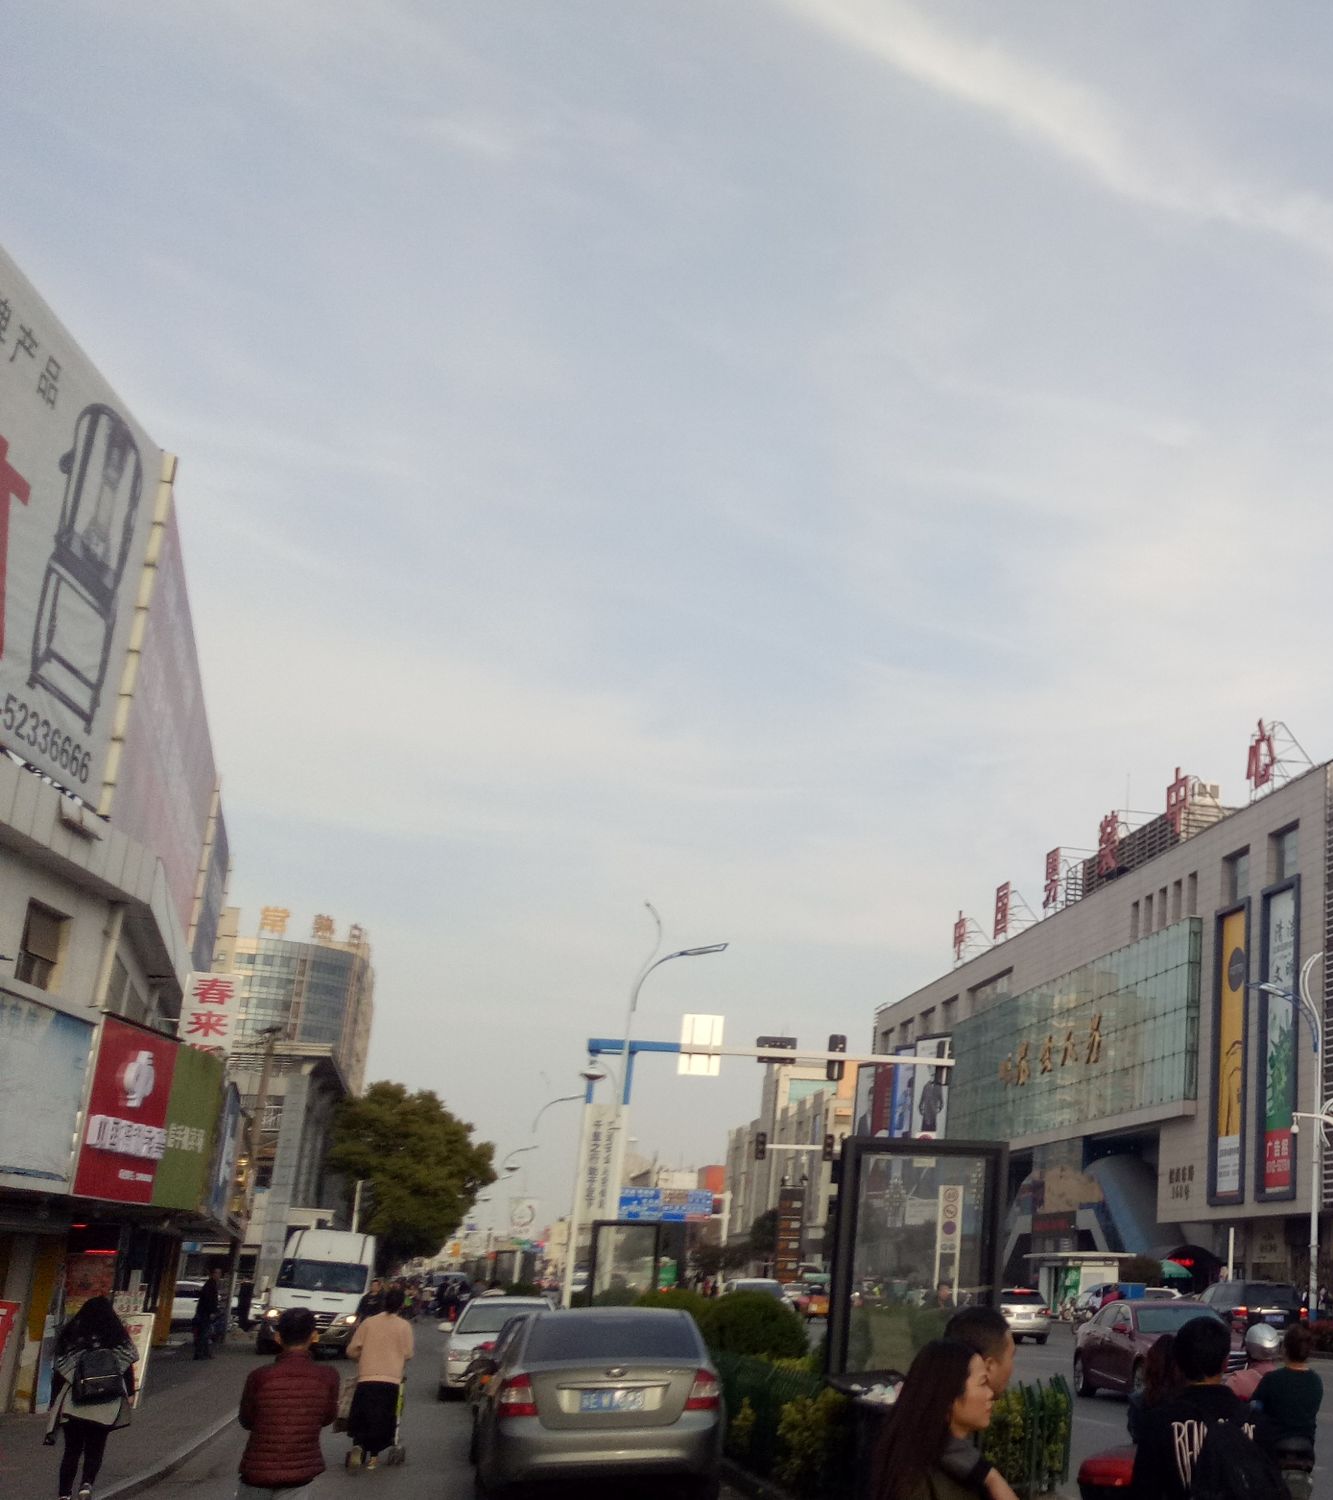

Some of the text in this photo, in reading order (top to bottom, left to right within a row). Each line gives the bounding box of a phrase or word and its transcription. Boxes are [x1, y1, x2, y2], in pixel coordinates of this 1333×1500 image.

[953, 718, 1276, 962] 中国男装中心
[184, 977, 237, 1053] 春来
